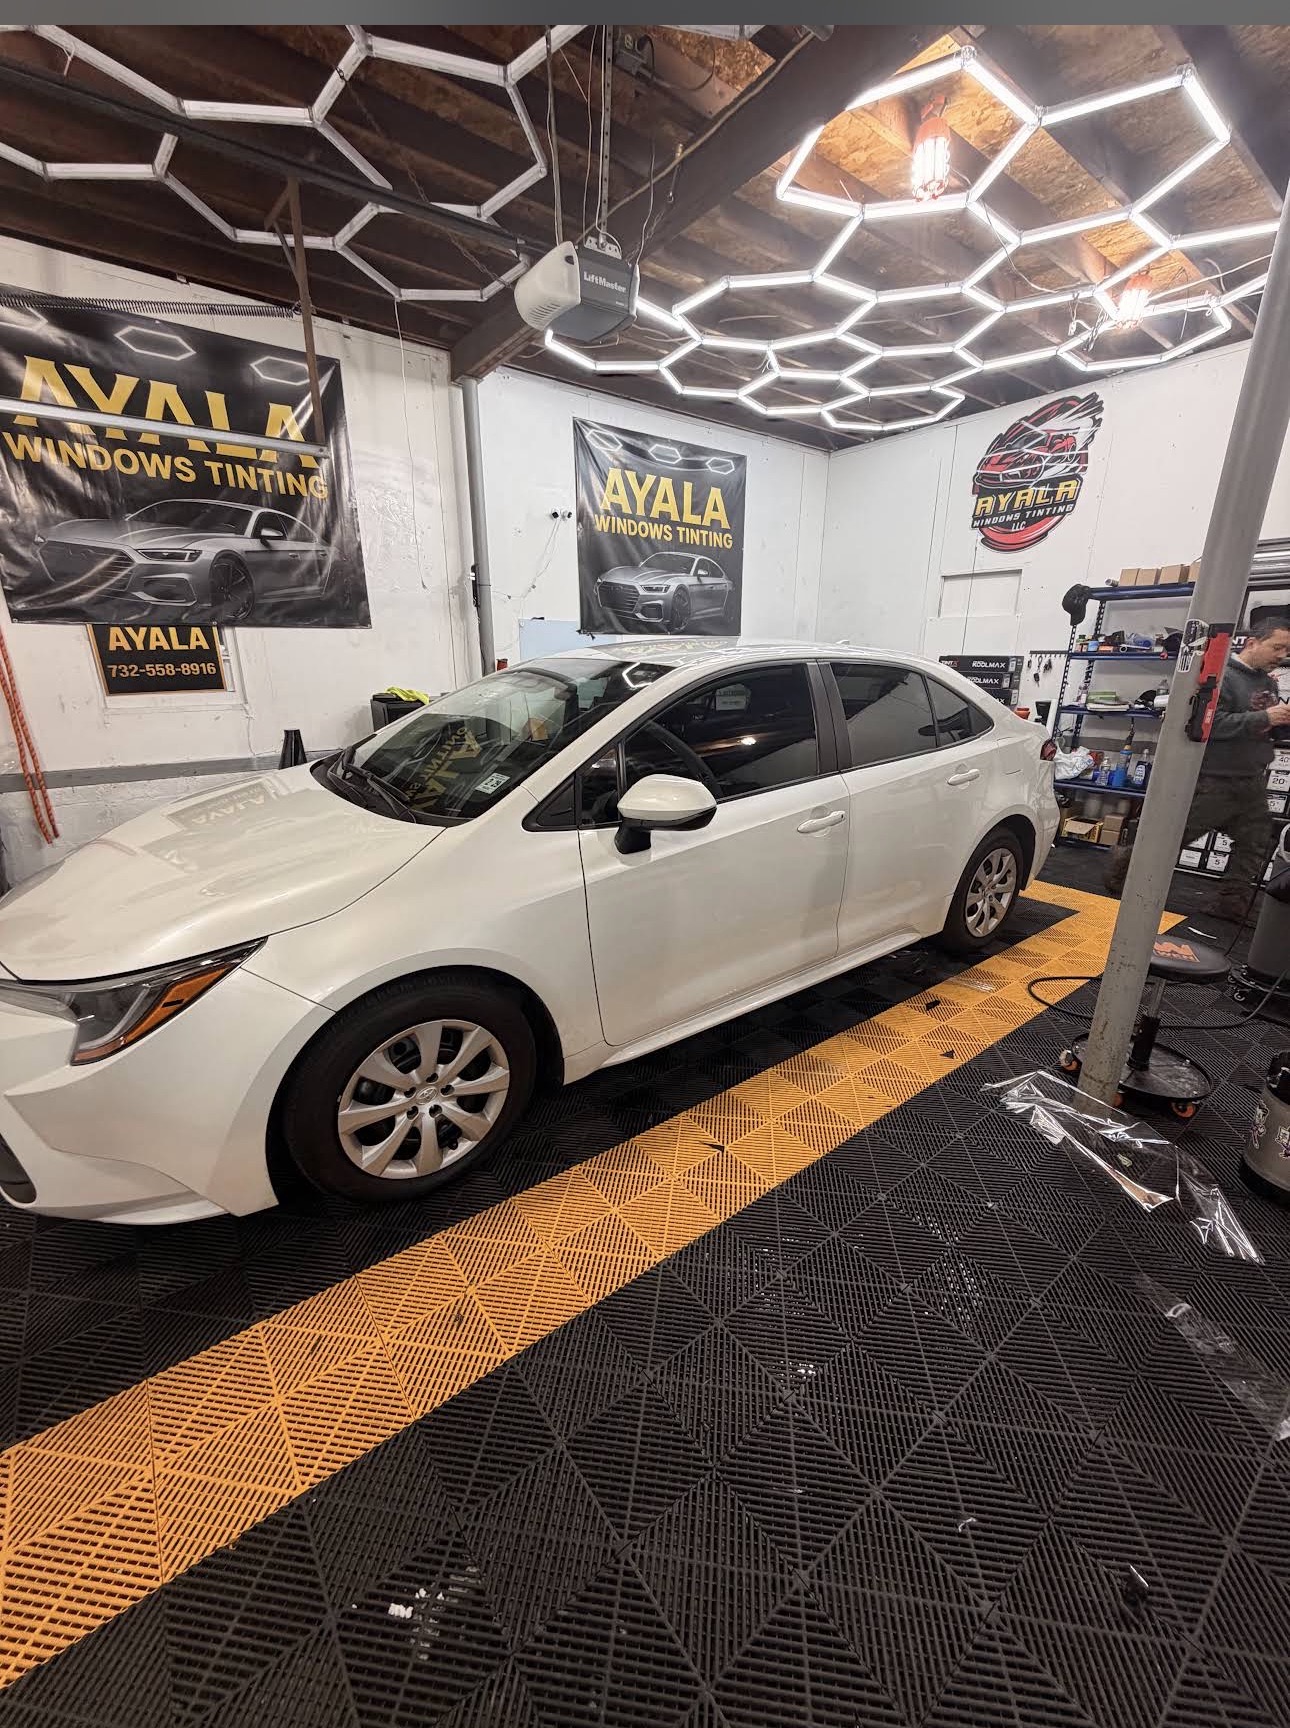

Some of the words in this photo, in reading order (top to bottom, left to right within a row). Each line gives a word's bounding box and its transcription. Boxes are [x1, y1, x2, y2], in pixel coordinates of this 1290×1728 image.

[583, 271, 626, 292] LiftMaster
[13, 355, 320, 468] AYALA
[2, 431, 197, 483] WINDOWS
[204, 460, 329, 499] TINTING
[601, 467, 731, 530] AYALA
[975, 479, 1080, 517] AYALA
[973, 512, 1021, 528] WINDOWS
[1025, 503, 1075, 519] TINTING
[1011, 521, 1027, 532] LLC
[595, 514, 673, 542] WINDOWS
[677, 526, 733, 549] TINTING
[108, 626, 211, 651] AYALA
[107, 662, 217, 678] 732-558-8916
[971, 660, 1006, 669] KOOLMAX
